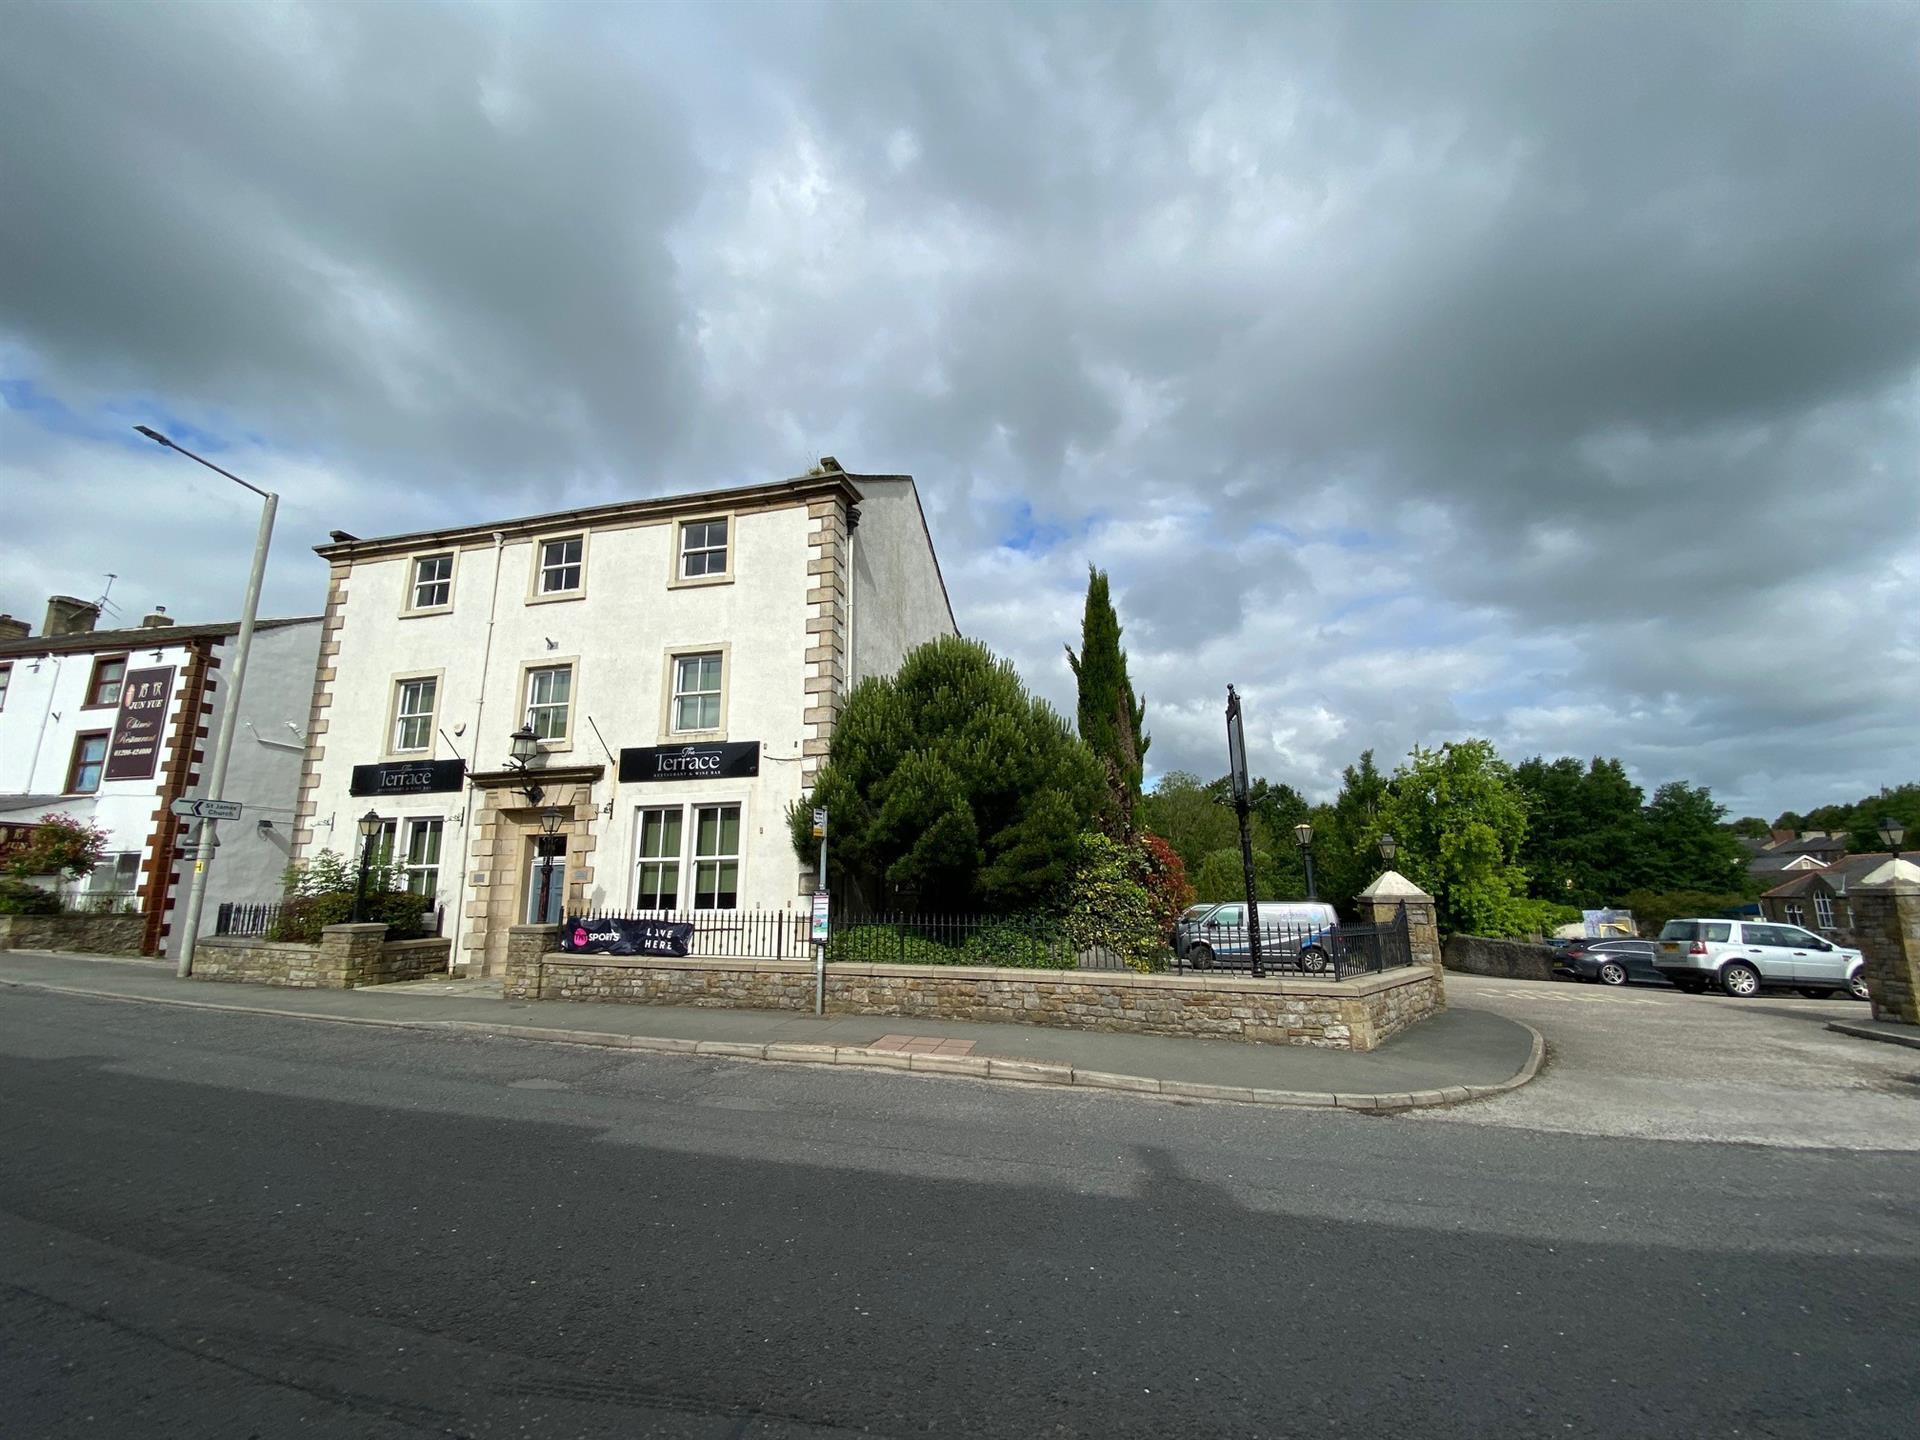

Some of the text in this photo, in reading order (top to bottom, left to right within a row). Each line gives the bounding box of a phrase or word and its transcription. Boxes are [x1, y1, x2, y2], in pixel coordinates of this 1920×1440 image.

[129, 699, 163, 710] JUN YUE
[655, 751, 722, 771] Terrace
[380, 768, 433, 787] Terrace
[208, 809, 233, 817] Church
[644, 939, 672, 951] HERE
